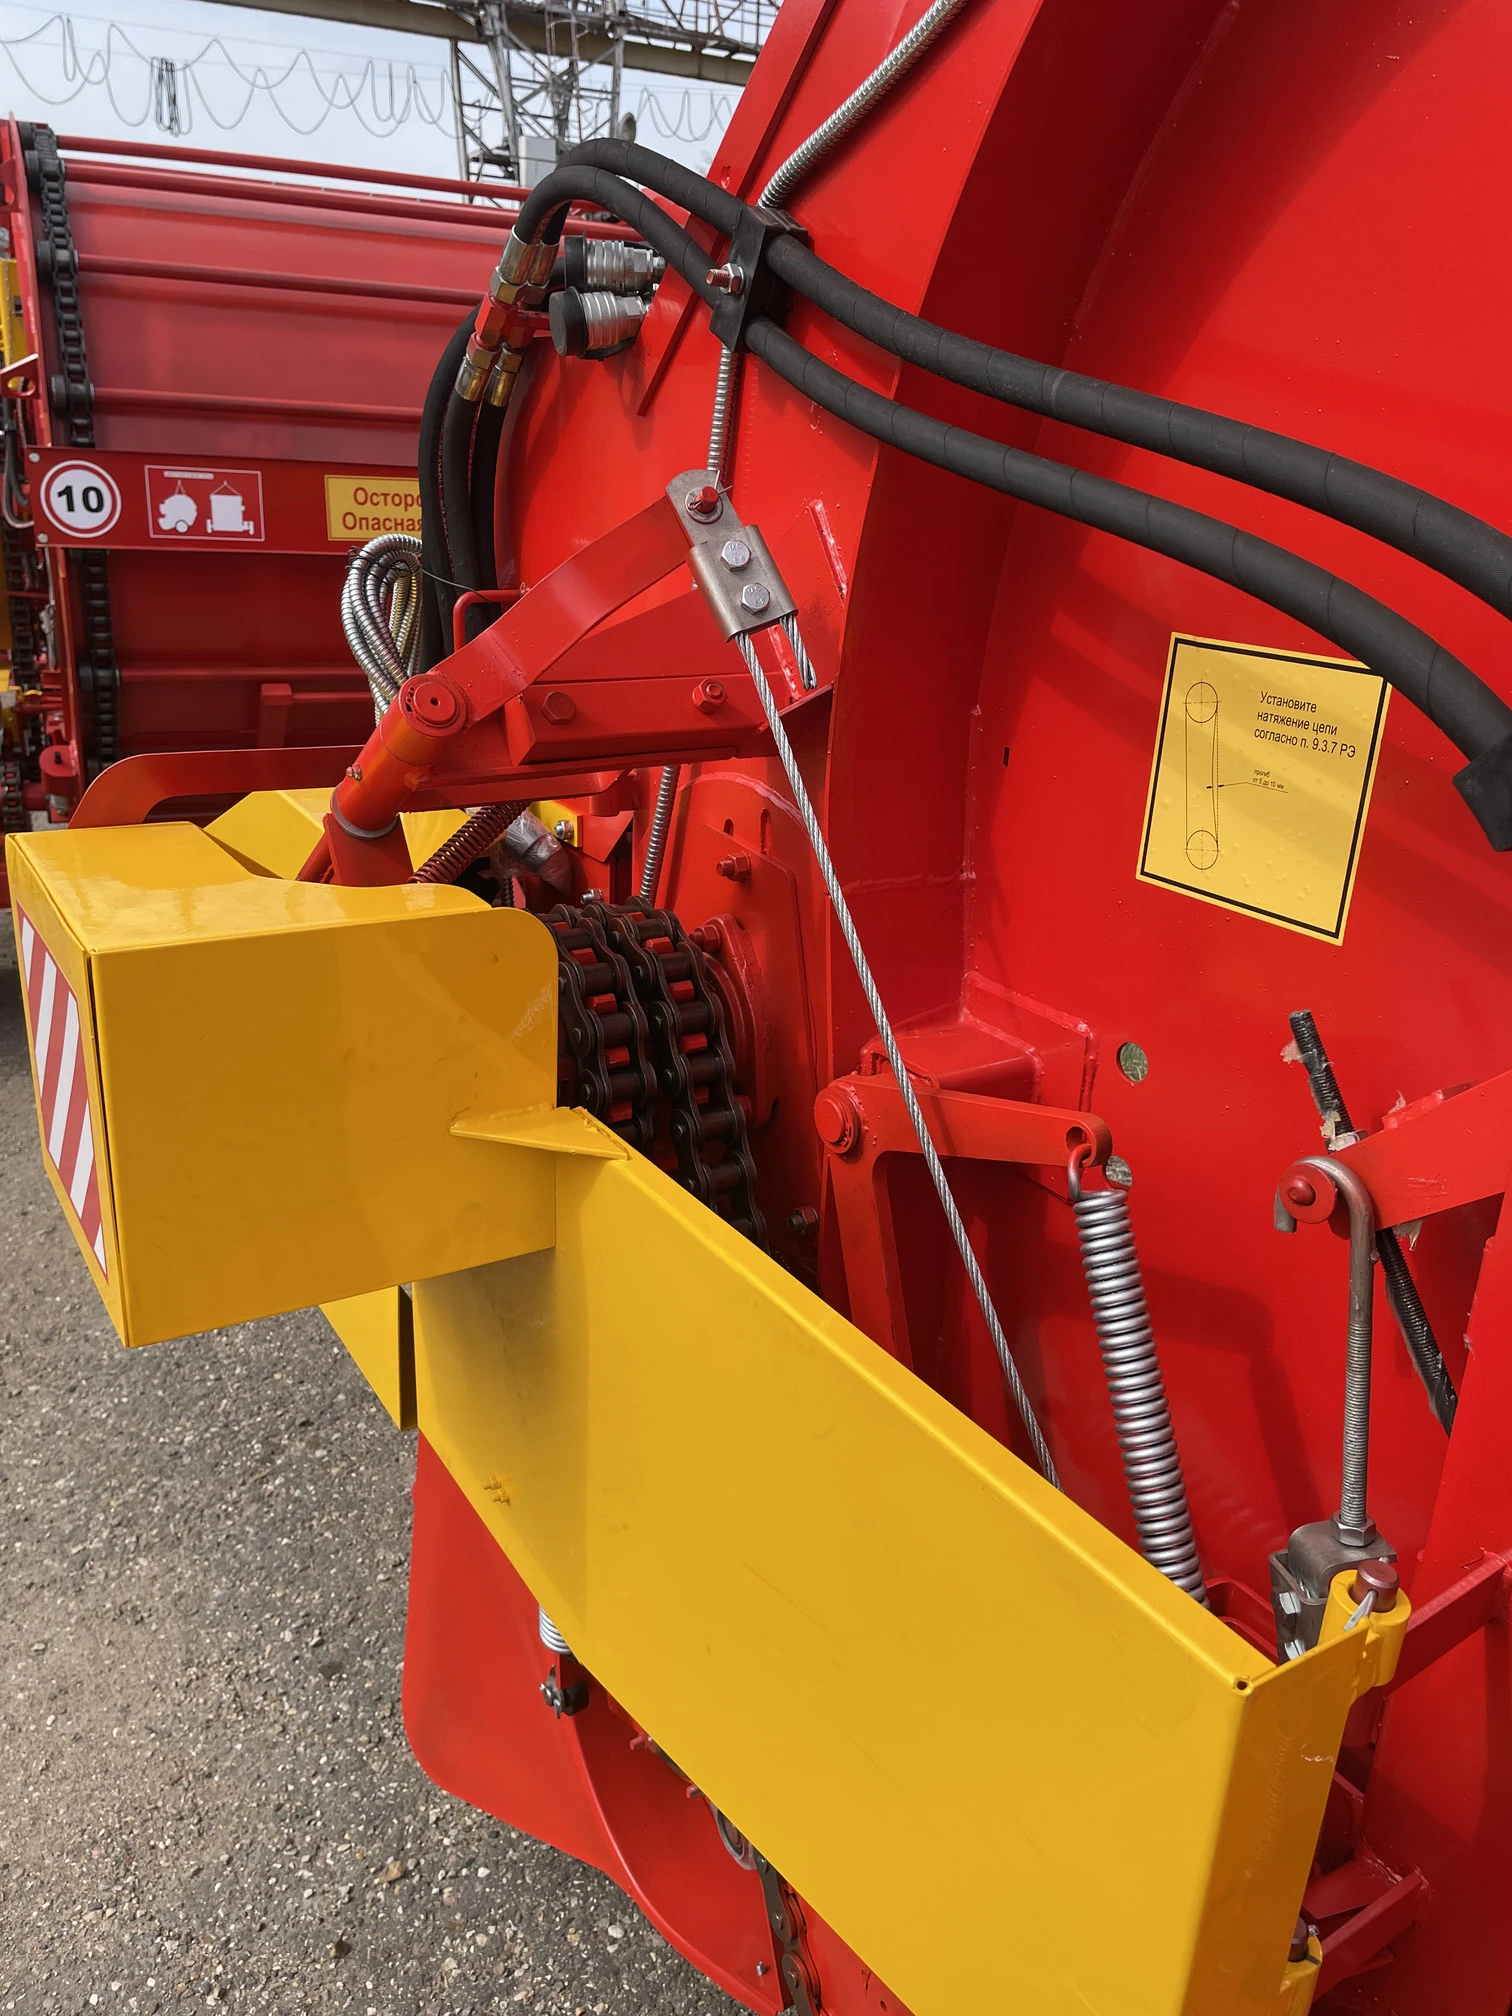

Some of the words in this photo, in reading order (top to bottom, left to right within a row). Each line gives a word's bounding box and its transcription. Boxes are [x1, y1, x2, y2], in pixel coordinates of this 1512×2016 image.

[57, 485, 104, 513] 10
[1260, 690, 1317, 713] Установите
[1257, 711, 1310, 730] натяжение
[1312, 722, 1337, 735] цепи
[1254, 728, 1298, 746] согласно
[1300, 738, 1309, 748] п.
[1312, 737, 1338, 754] 9.3.7
[1339, 743, 1356, 758] РЭ
[1270, 780, 1276, 788] 10
